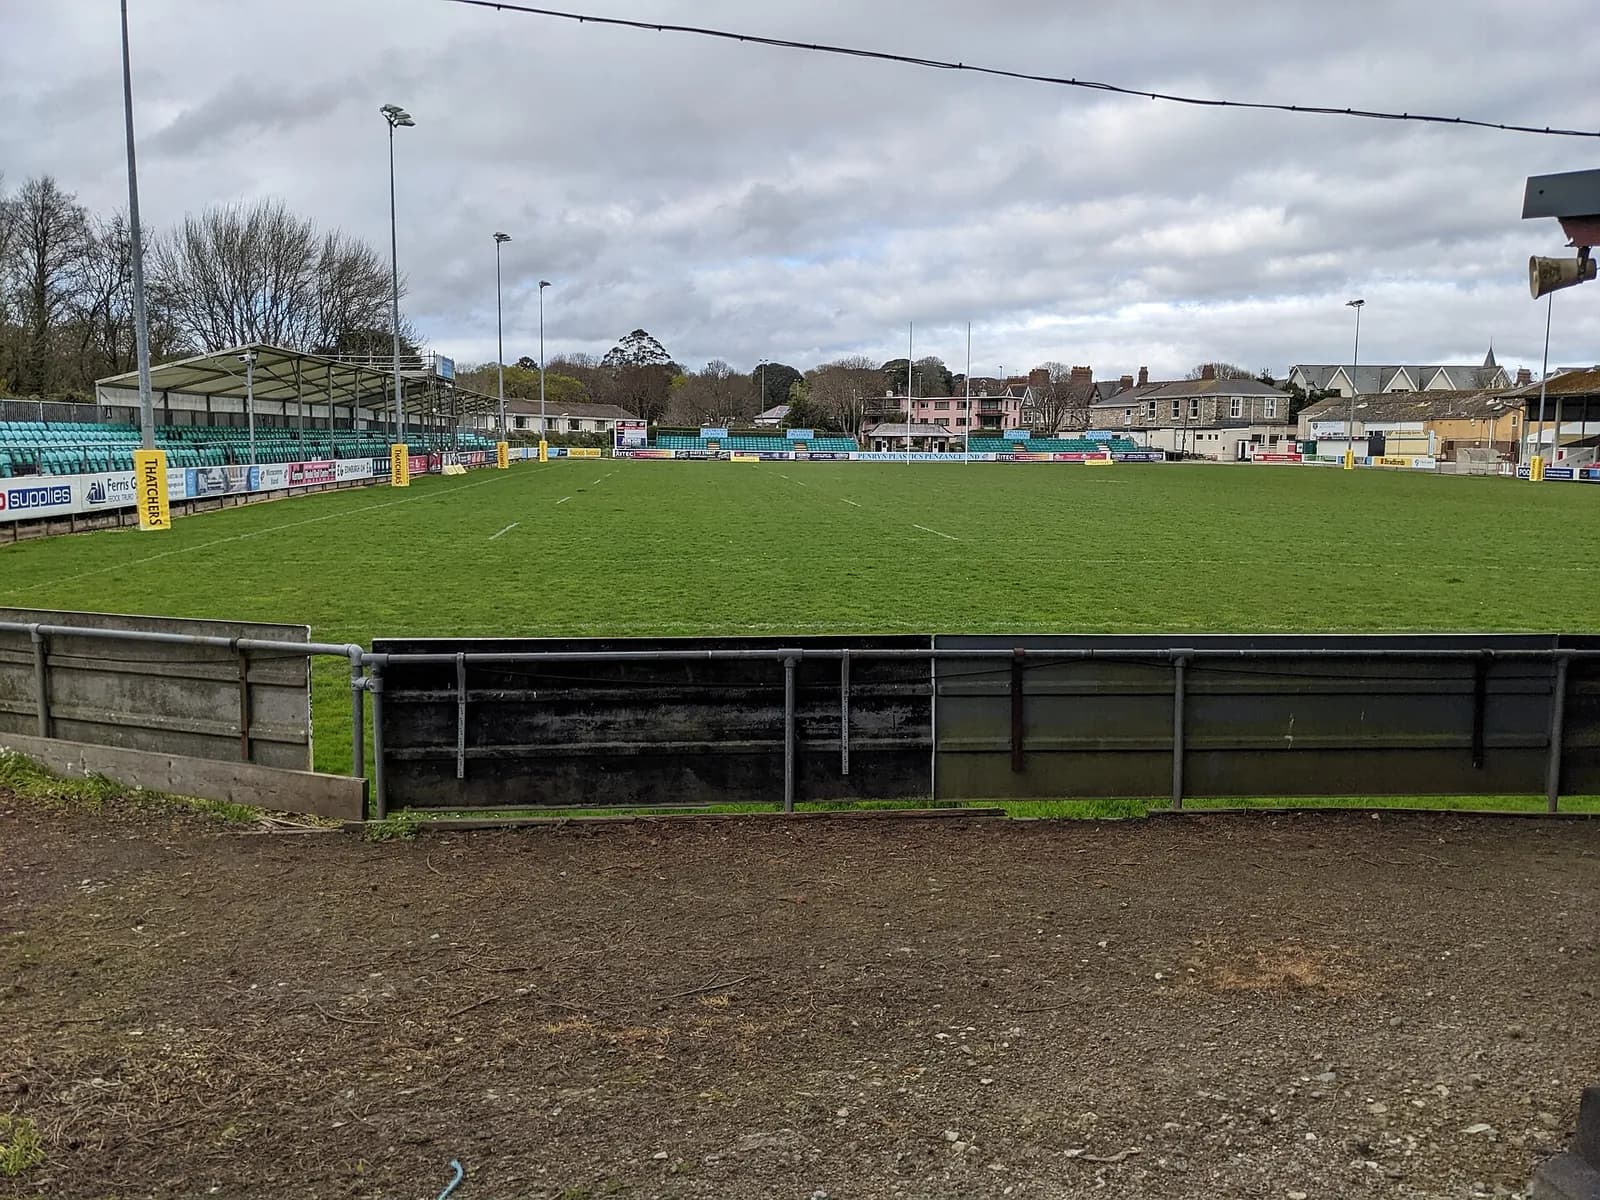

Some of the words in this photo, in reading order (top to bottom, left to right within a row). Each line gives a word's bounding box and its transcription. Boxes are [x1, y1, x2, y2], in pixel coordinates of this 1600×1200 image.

[107, 477, 129, 492] Ferris
[145, 459, 162, 525] THATCHERS
[10, 486, 71, 510] supplies
